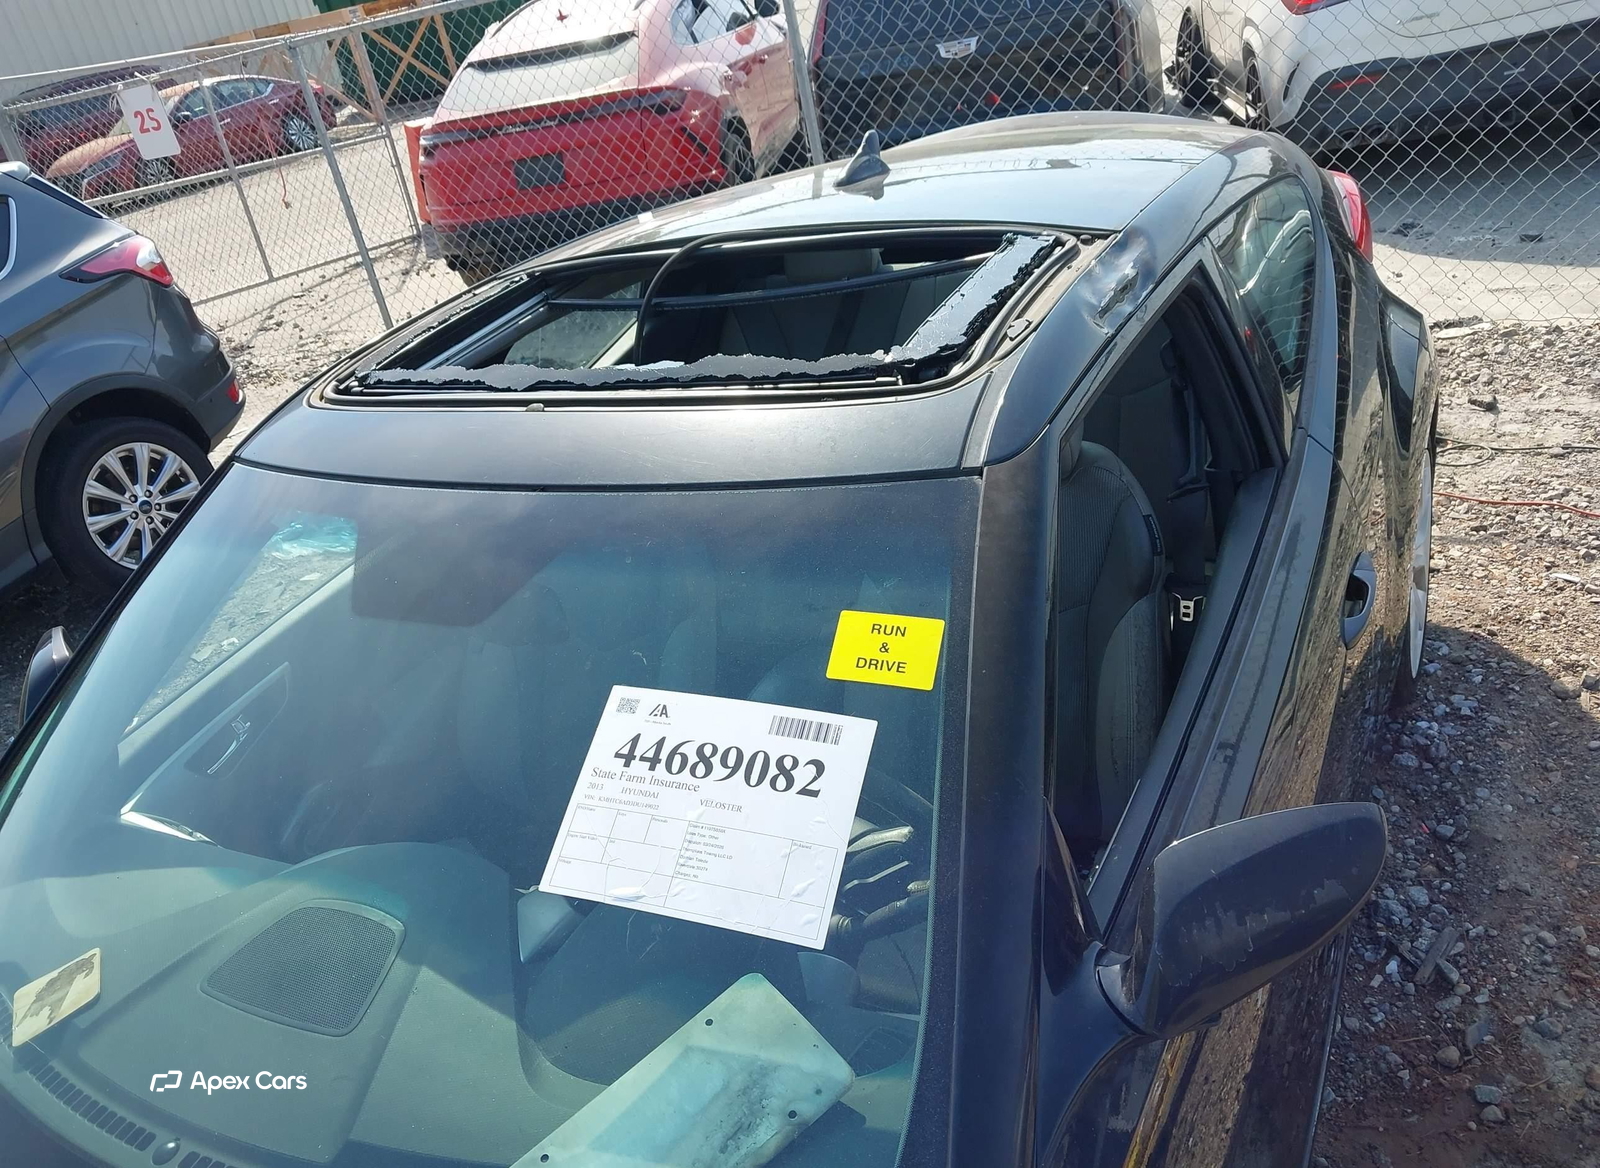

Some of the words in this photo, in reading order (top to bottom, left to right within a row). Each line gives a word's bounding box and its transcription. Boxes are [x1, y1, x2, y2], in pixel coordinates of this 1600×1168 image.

[134, 108, 161, 134] 25
[871, 624, 907, 637] RUN
[879, 642, 890, 653] &
[856, 657, 907, 673] DRIVE
[613, 732, 826, 798] 44689082
[591, 767, 617, 781] State
[619, 770, 646, 785] Farm
[649, 775, 700, 793] Insurance
[587, 782, 604, 790] 2013
[621, 786, 659, 799] HYUNDAI
[700, 799, 742, 812] VELOSTER
